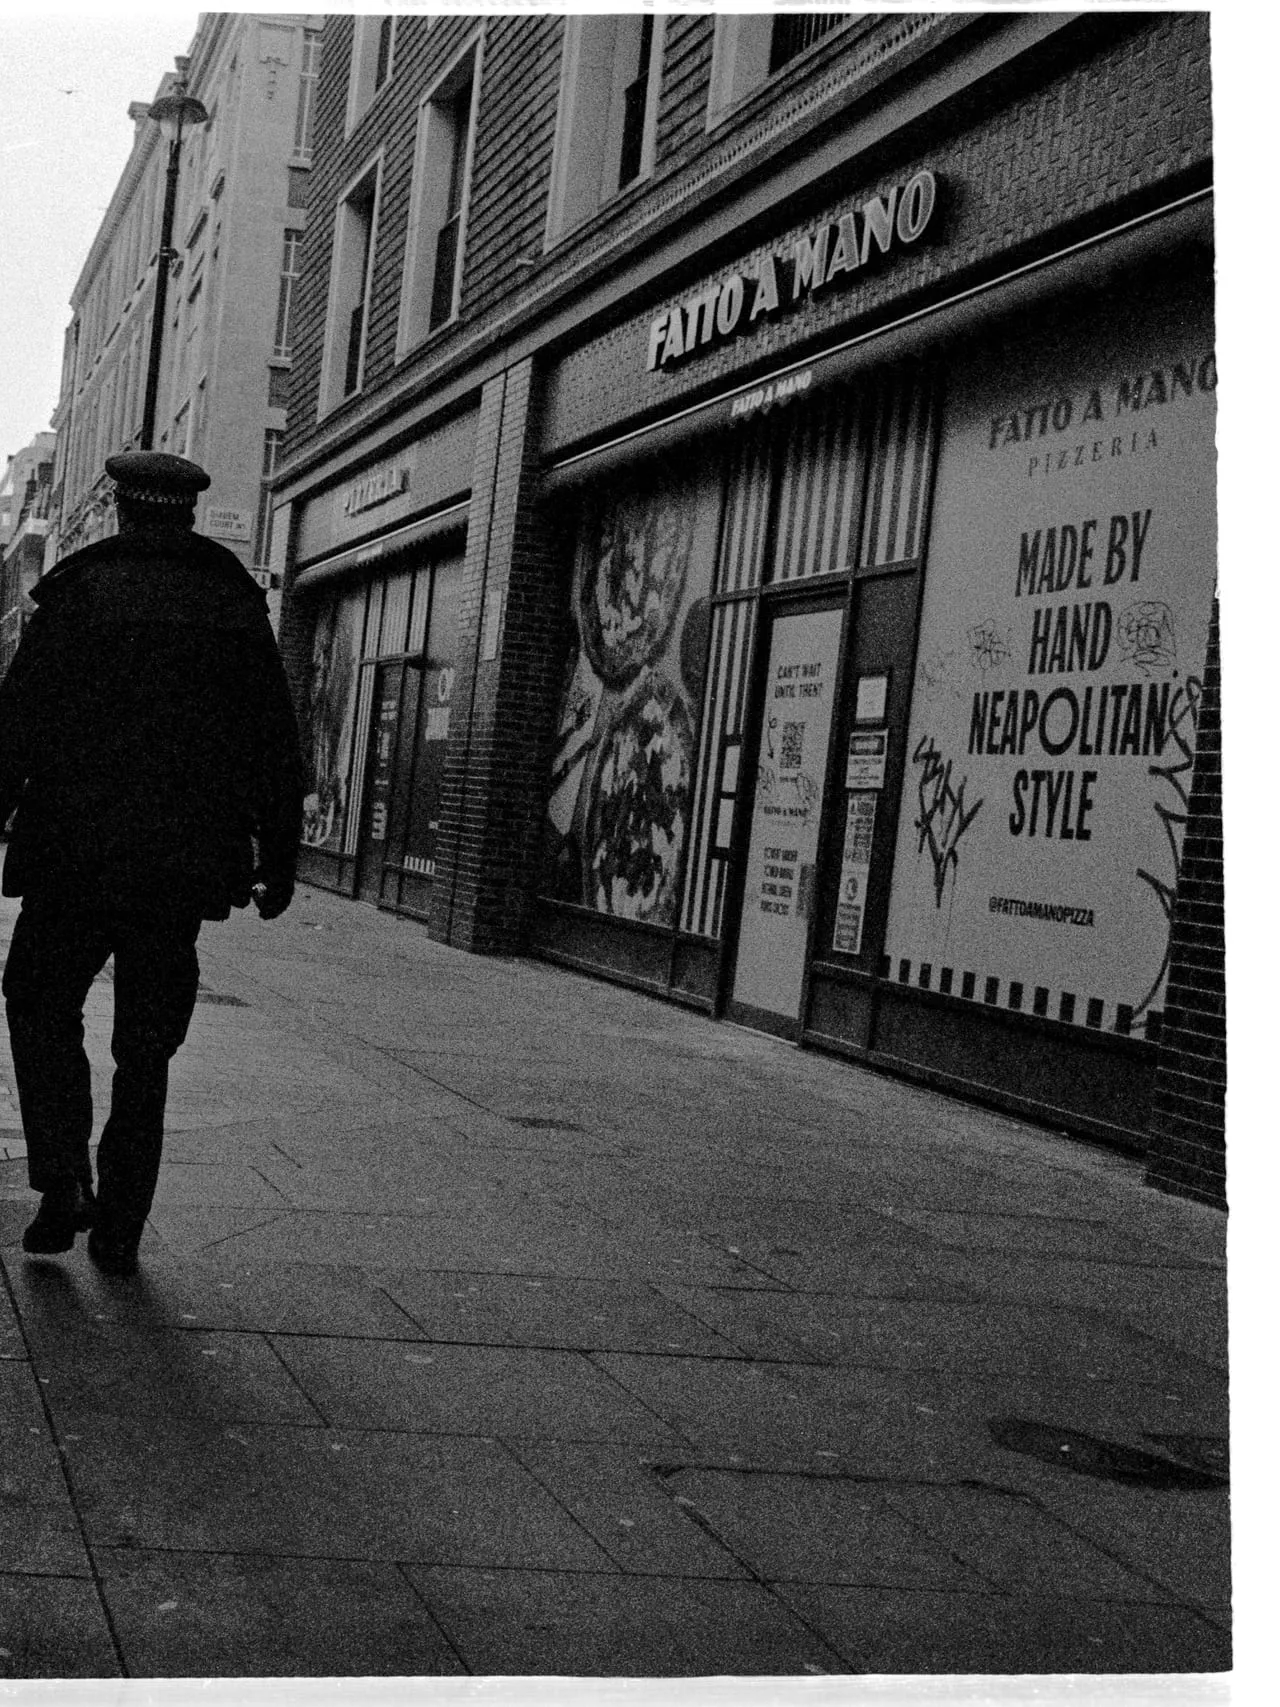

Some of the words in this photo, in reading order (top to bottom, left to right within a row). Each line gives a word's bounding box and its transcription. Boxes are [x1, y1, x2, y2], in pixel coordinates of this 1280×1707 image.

[646, 274, 745, 373] FATTO
[749, 255, 780, 321] A
[793, 170, 936, 300] MANO
[730, 390, 763, 417] FATTO
[774, 370, 812, 399] MANO
[988, 398, 1073, 450] FATTO
[1082, 388, 1104, 423] A
[1116, 354, 1217, 417] MANO
[1027, 428, 1158, 478] PIZZERIA
[1015, 519, 1098, 598] MADE
[1103, 508, 1153, 586] BY
[1028, 601, 1112, 675] HAND
[968, 683, 1170, 757] NEAPOLITAN
[1009, 769, 1098, 841] STYLE
[989, 896, 1095, 928] @FATTOAMANOPIZZA
